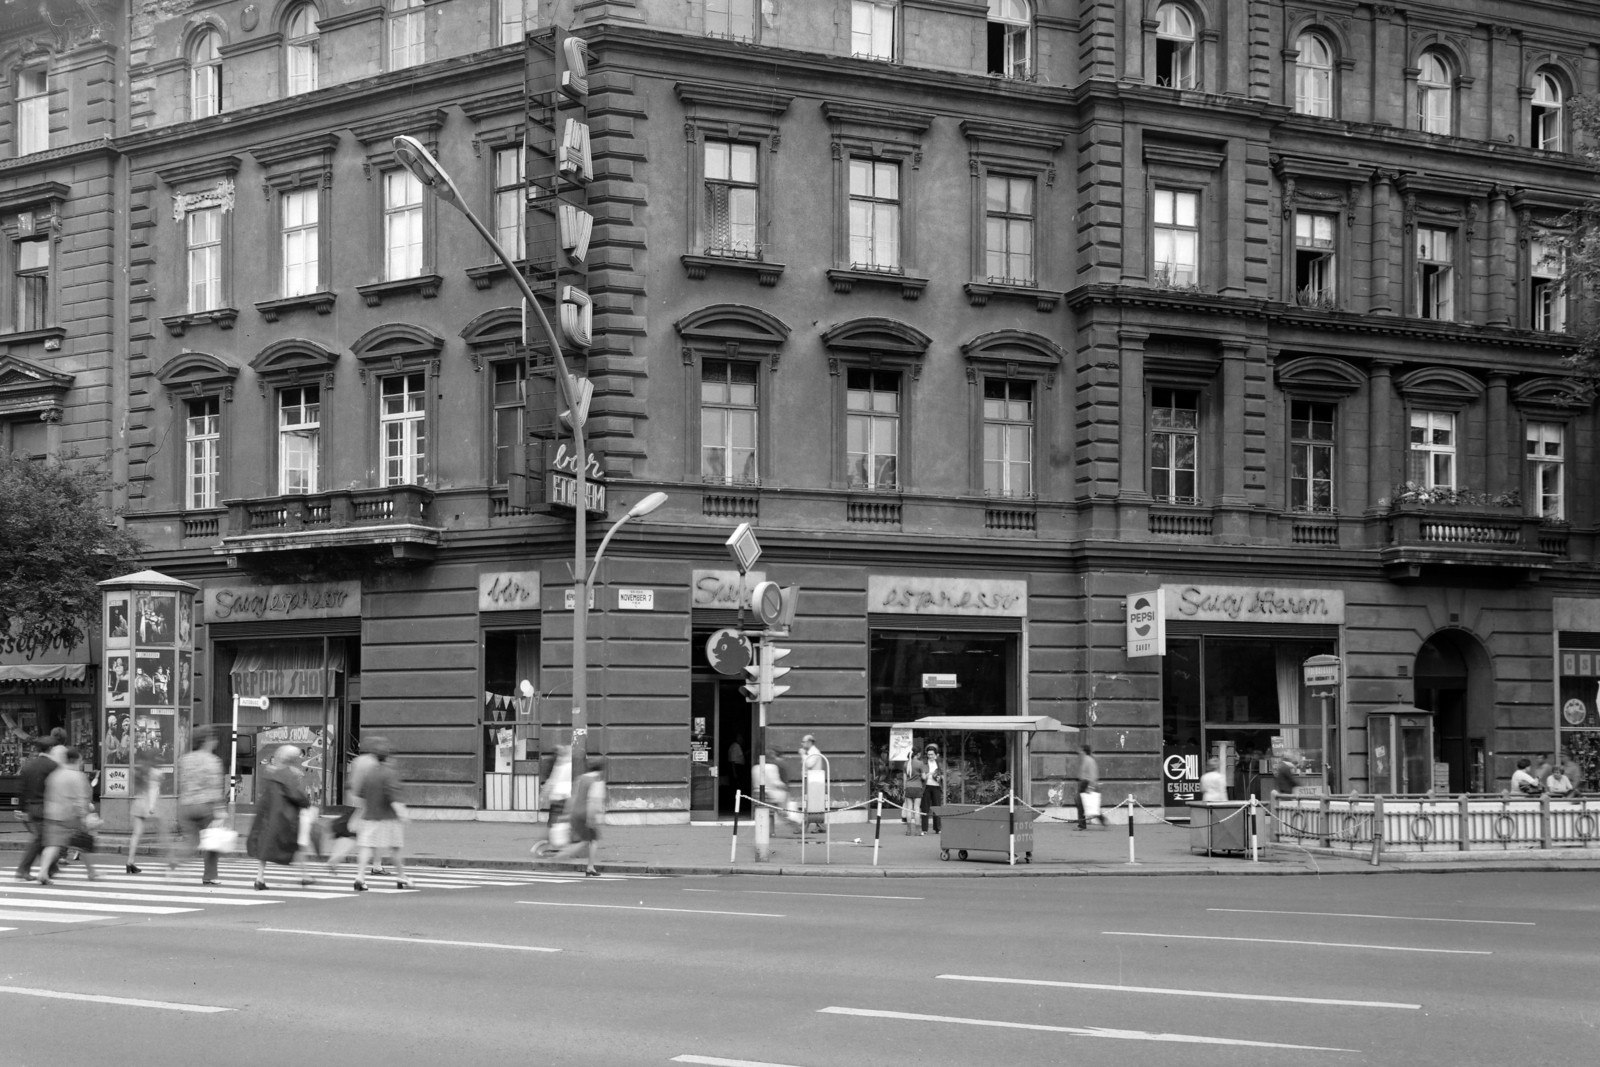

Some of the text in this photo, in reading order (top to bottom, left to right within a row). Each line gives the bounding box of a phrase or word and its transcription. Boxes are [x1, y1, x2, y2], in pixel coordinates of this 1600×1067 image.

[559, 36, 594, 430] SAVOY
[620, 593, 652, 602] NOVEMBER 7
[1130, 610, 1155, 624] PEPSI
[1135, 643, 1151, 652] SAVOY
[288, 670, 335, 696] SHOW
[1163, 754, 1200, 780] GRILL
[1014, 821, 1034, 831] TOTO
